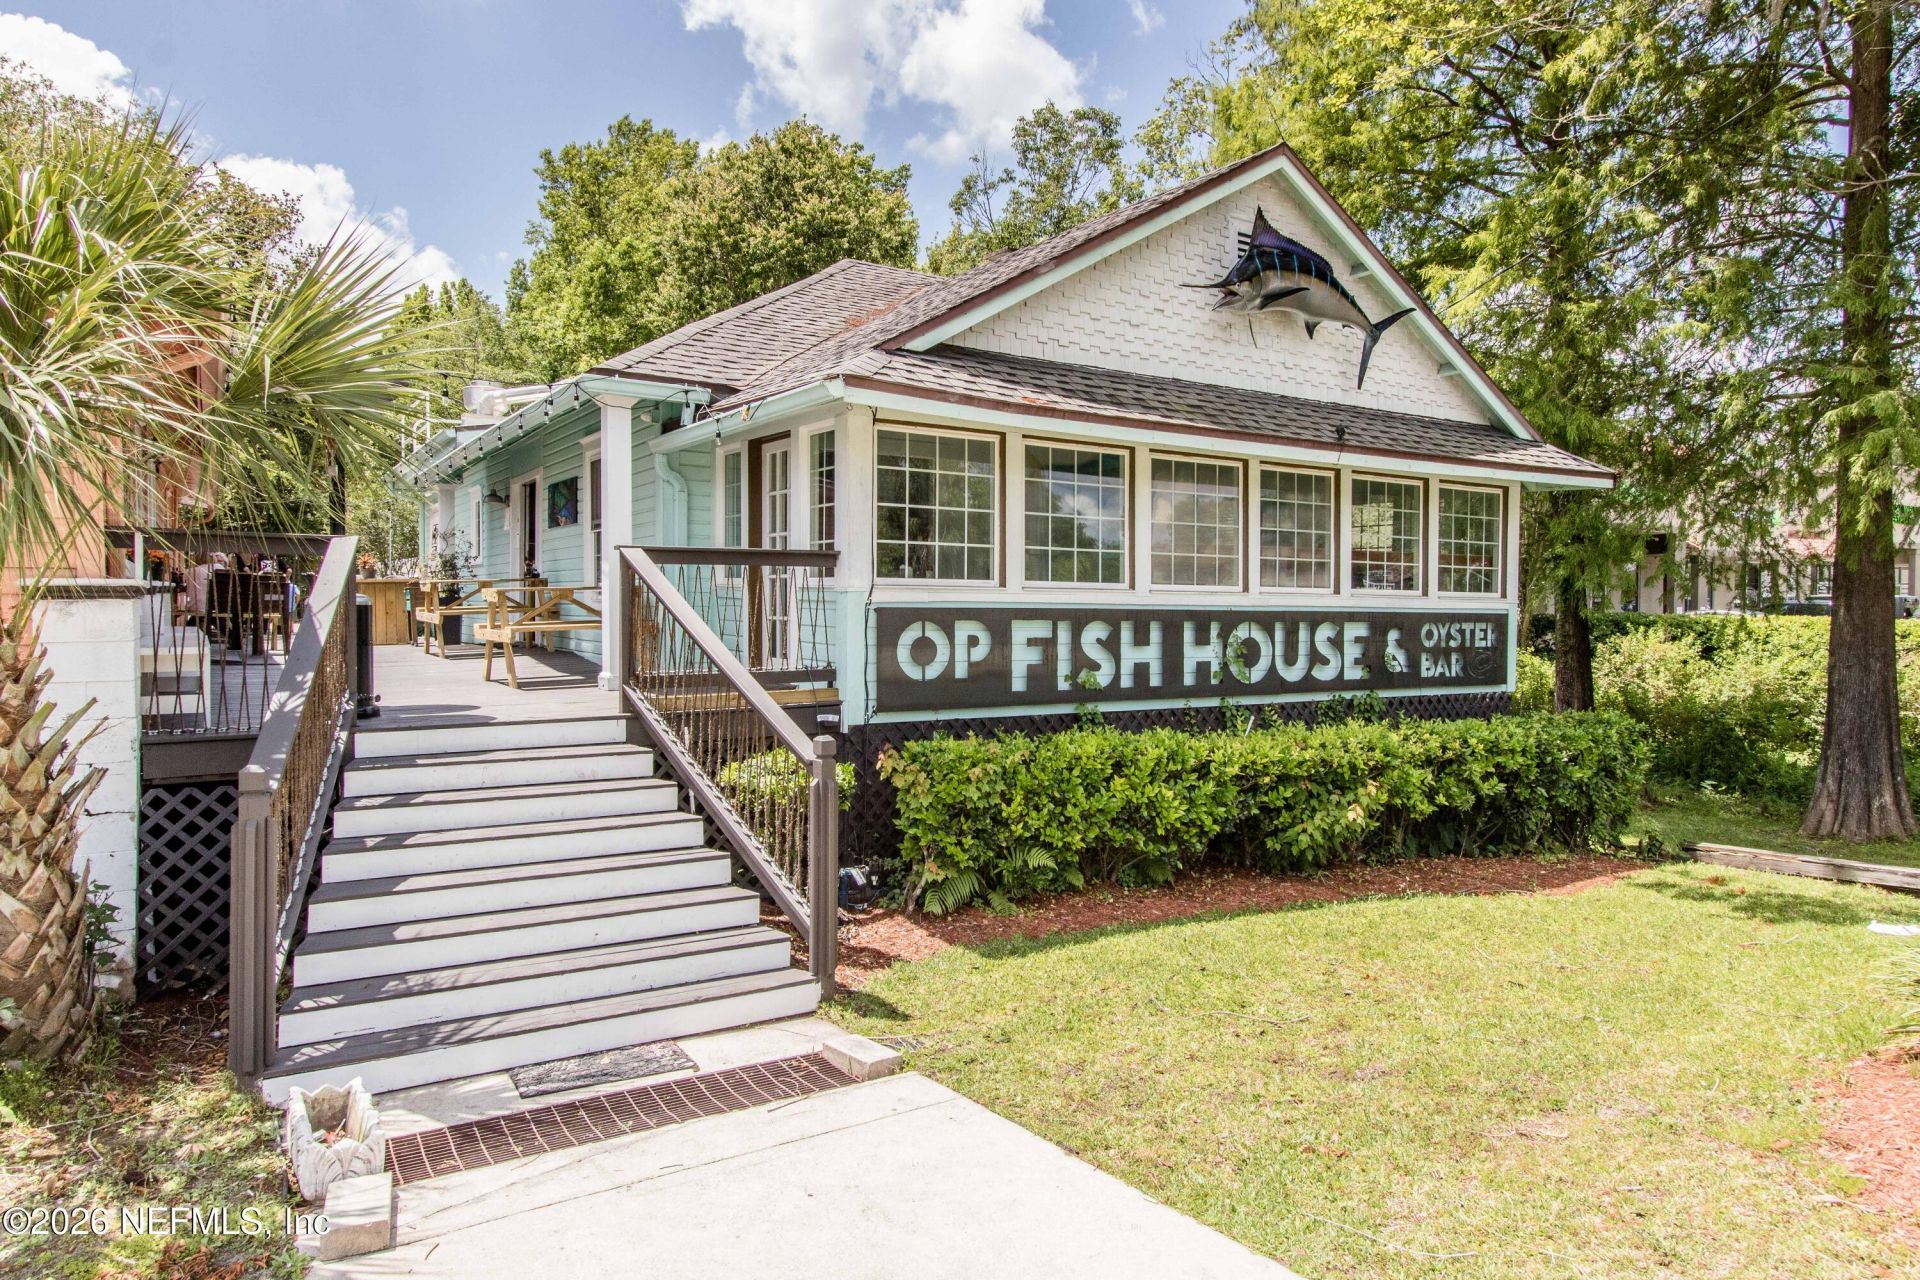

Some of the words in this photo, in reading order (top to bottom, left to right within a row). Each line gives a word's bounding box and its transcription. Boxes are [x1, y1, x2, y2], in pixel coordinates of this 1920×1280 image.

[1420, 622, 1498, 648] OYSTER
[896, 620, 992, 682] OP
[1011, 620, 1164, 692] FISH
[1183, 621, 1372, 686] HOUSE
[1384, 627, 1409, 673] &
[1420, 652, 1465, 678] BAR
